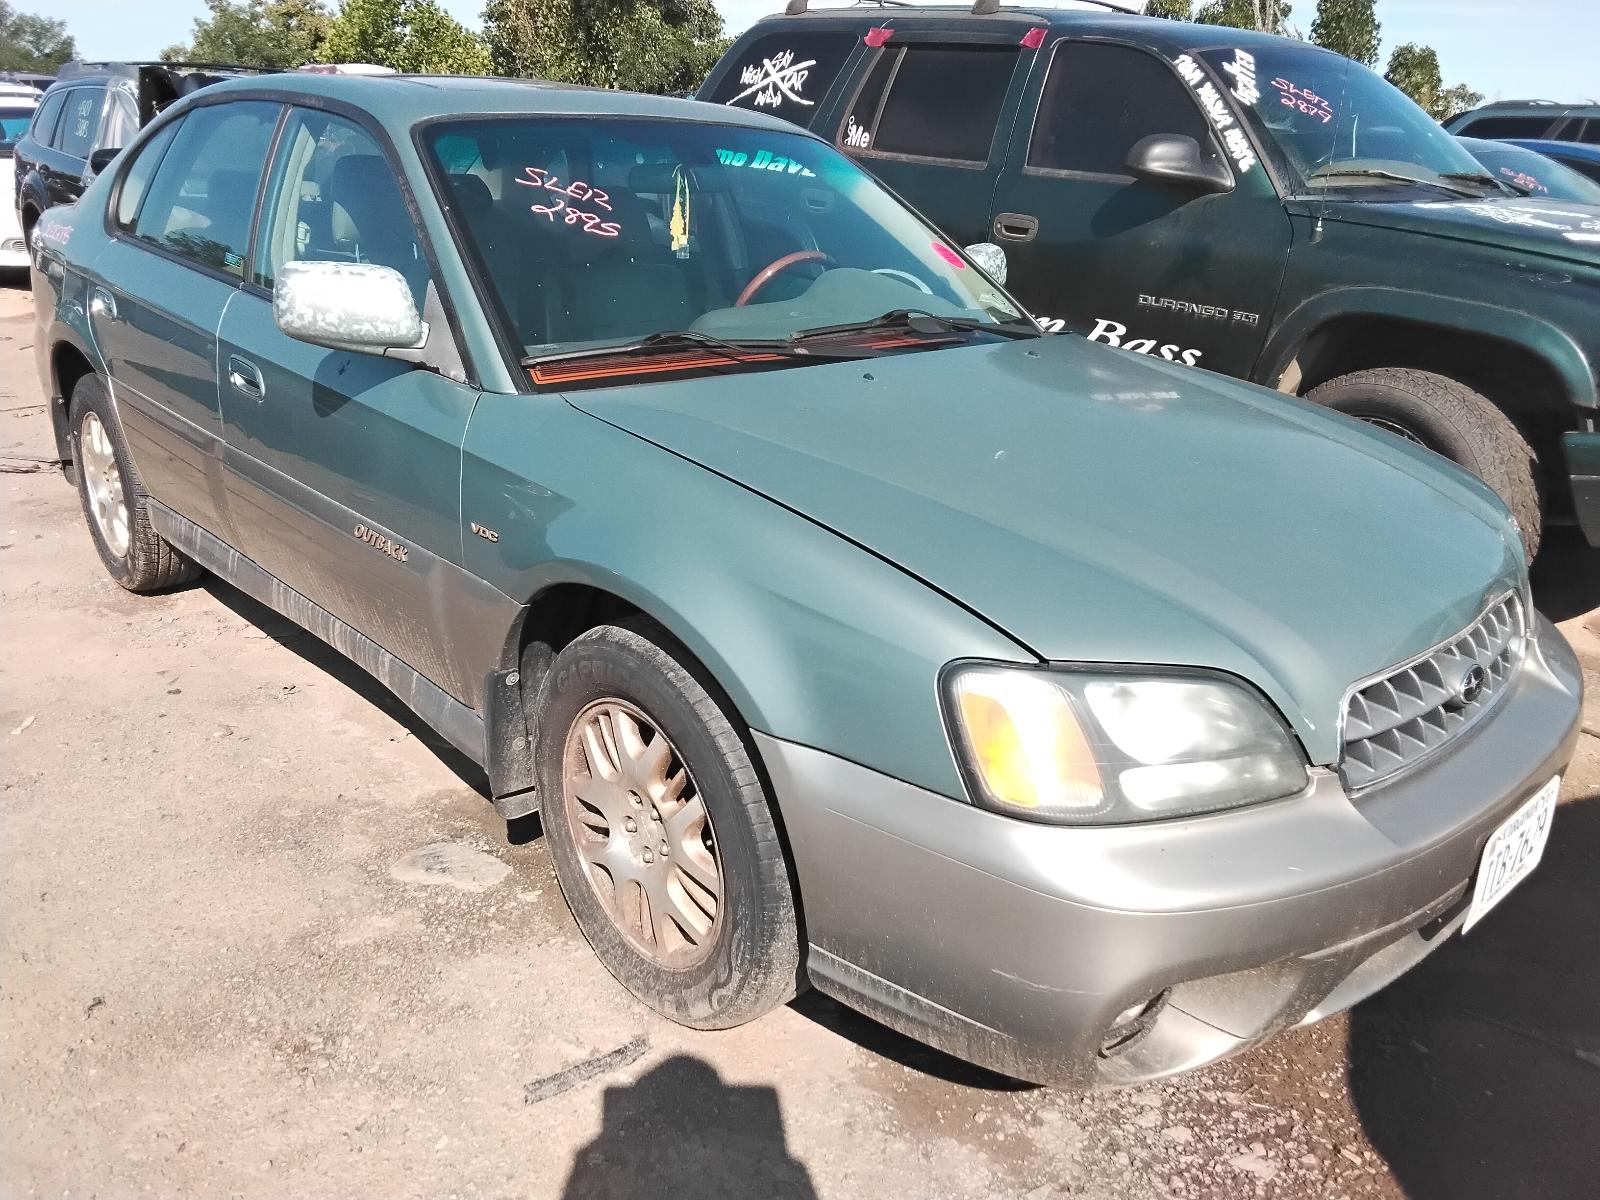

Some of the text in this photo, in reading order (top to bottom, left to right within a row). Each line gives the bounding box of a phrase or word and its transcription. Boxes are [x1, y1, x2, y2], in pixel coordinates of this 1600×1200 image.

[1138, 293, 1229, 319] DURANGO
[353, 523, 409, 563] OUTBACK
[470, 521, 500, 543] VDC
